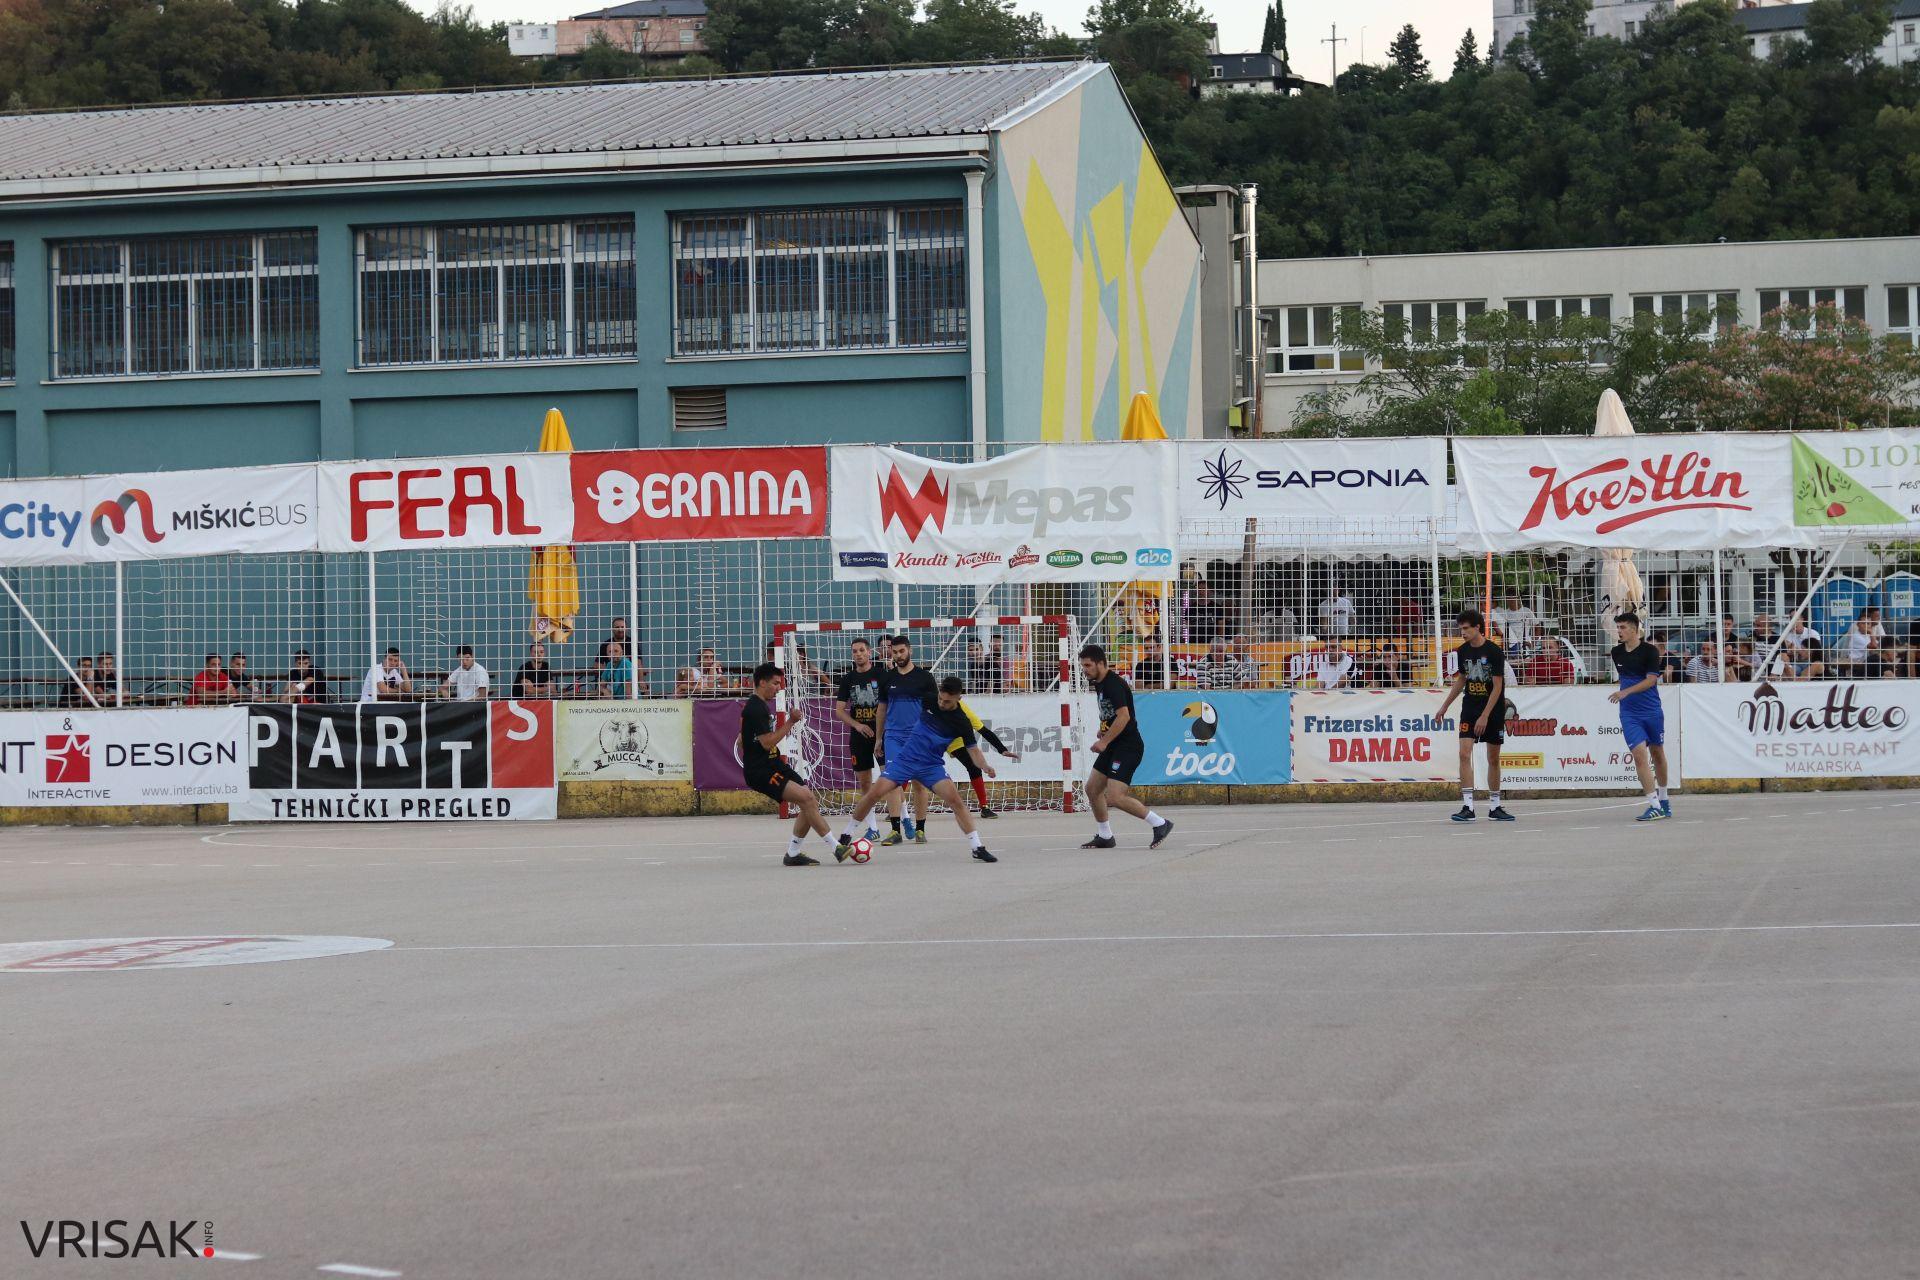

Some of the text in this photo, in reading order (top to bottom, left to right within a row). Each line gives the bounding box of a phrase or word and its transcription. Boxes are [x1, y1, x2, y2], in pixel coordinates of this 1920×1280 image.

[1842, 445, 1920, 468] DIO
[1256, 468, 1429, 488] SAPONIA
[350, 466, 541, 542] FEAL
[587, 469, 811, 524] BERNINA
[1519, 451, 1752, 534] Koestlin
[951, 478, 1135, 538] Mepas
[0, 501, 82, 548] City
[894, 551, 950, 568] Kandit
[955, 551, 1003, 568] Koestlin
[1095, 553, 1123, 562] paloma
[1138, 550, 1169, 564] abc
[62, 717, 73, 731] &
[1304, 714, 1455, 733] Frizerski salon
[106, 740, 236, 767] DESIGN
[607, 752, 641, 763] MUCCA
[1329, 737, 1431, 763] DAMAC
[1755, 741, 1901, 757] RESTAURANT
[1165, 747, 1236, 776] toco
[1785, 760, 1863, 773] MAKARSKA
[142, 784, 238, 796] www.interactiv.ba
[272, 793, 511, 818] TEHNIČKI PREGLED
